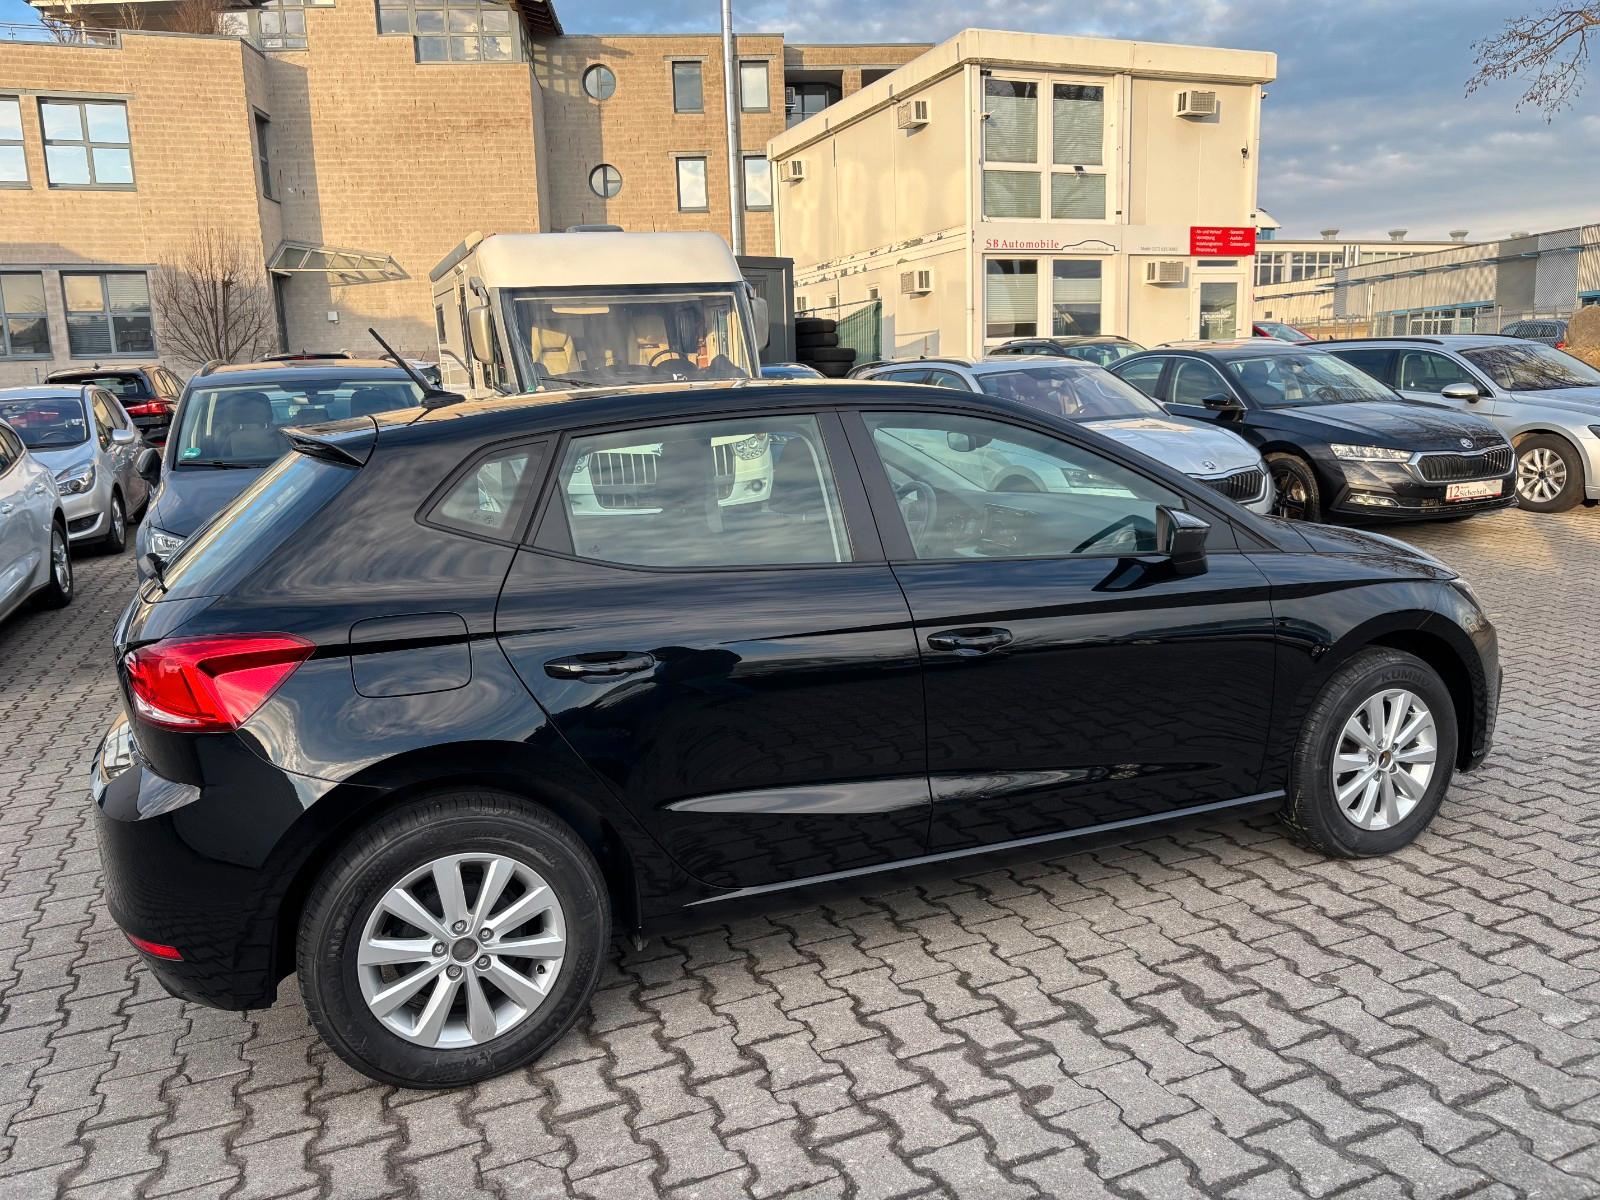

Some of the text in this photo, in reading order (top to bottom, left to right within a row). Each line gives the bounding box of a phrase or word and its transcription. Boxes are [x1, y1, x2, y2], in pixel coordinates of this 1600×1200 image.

[986, 239, 1060, 249] SB Automobile
[1448, 485, 1460, 498] 12
